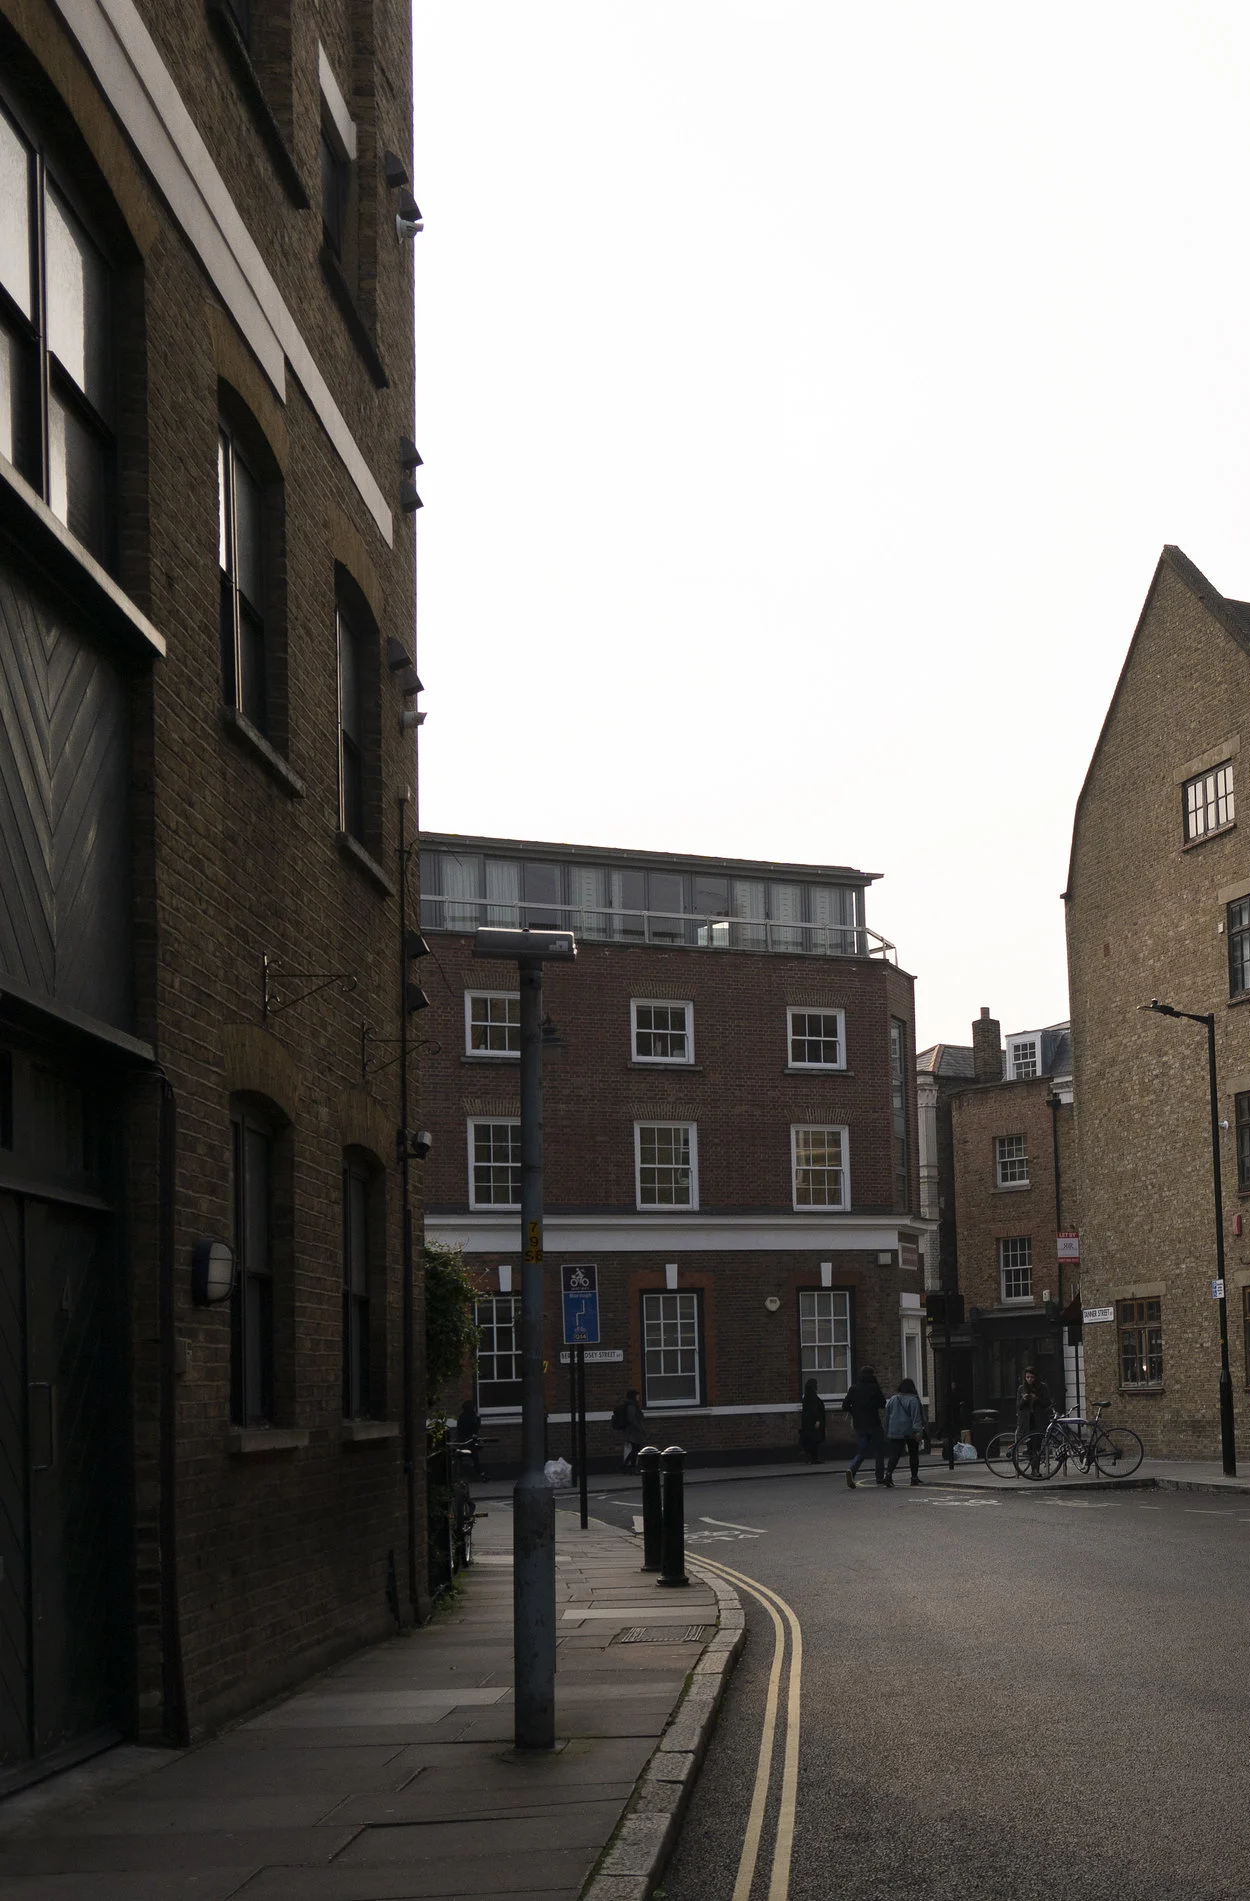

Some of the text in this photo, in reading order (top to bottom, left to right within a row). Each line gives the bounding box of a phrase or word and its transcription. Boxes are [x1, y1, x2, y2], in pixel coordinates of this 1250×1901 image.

[62, 1276, 76, 1320] 4
[1083, 1310, 1097, 1319] TANNER
[1097, 1308, 1110, 1317] STREET
[561, 1352, 597, 1360] BERDSEY
